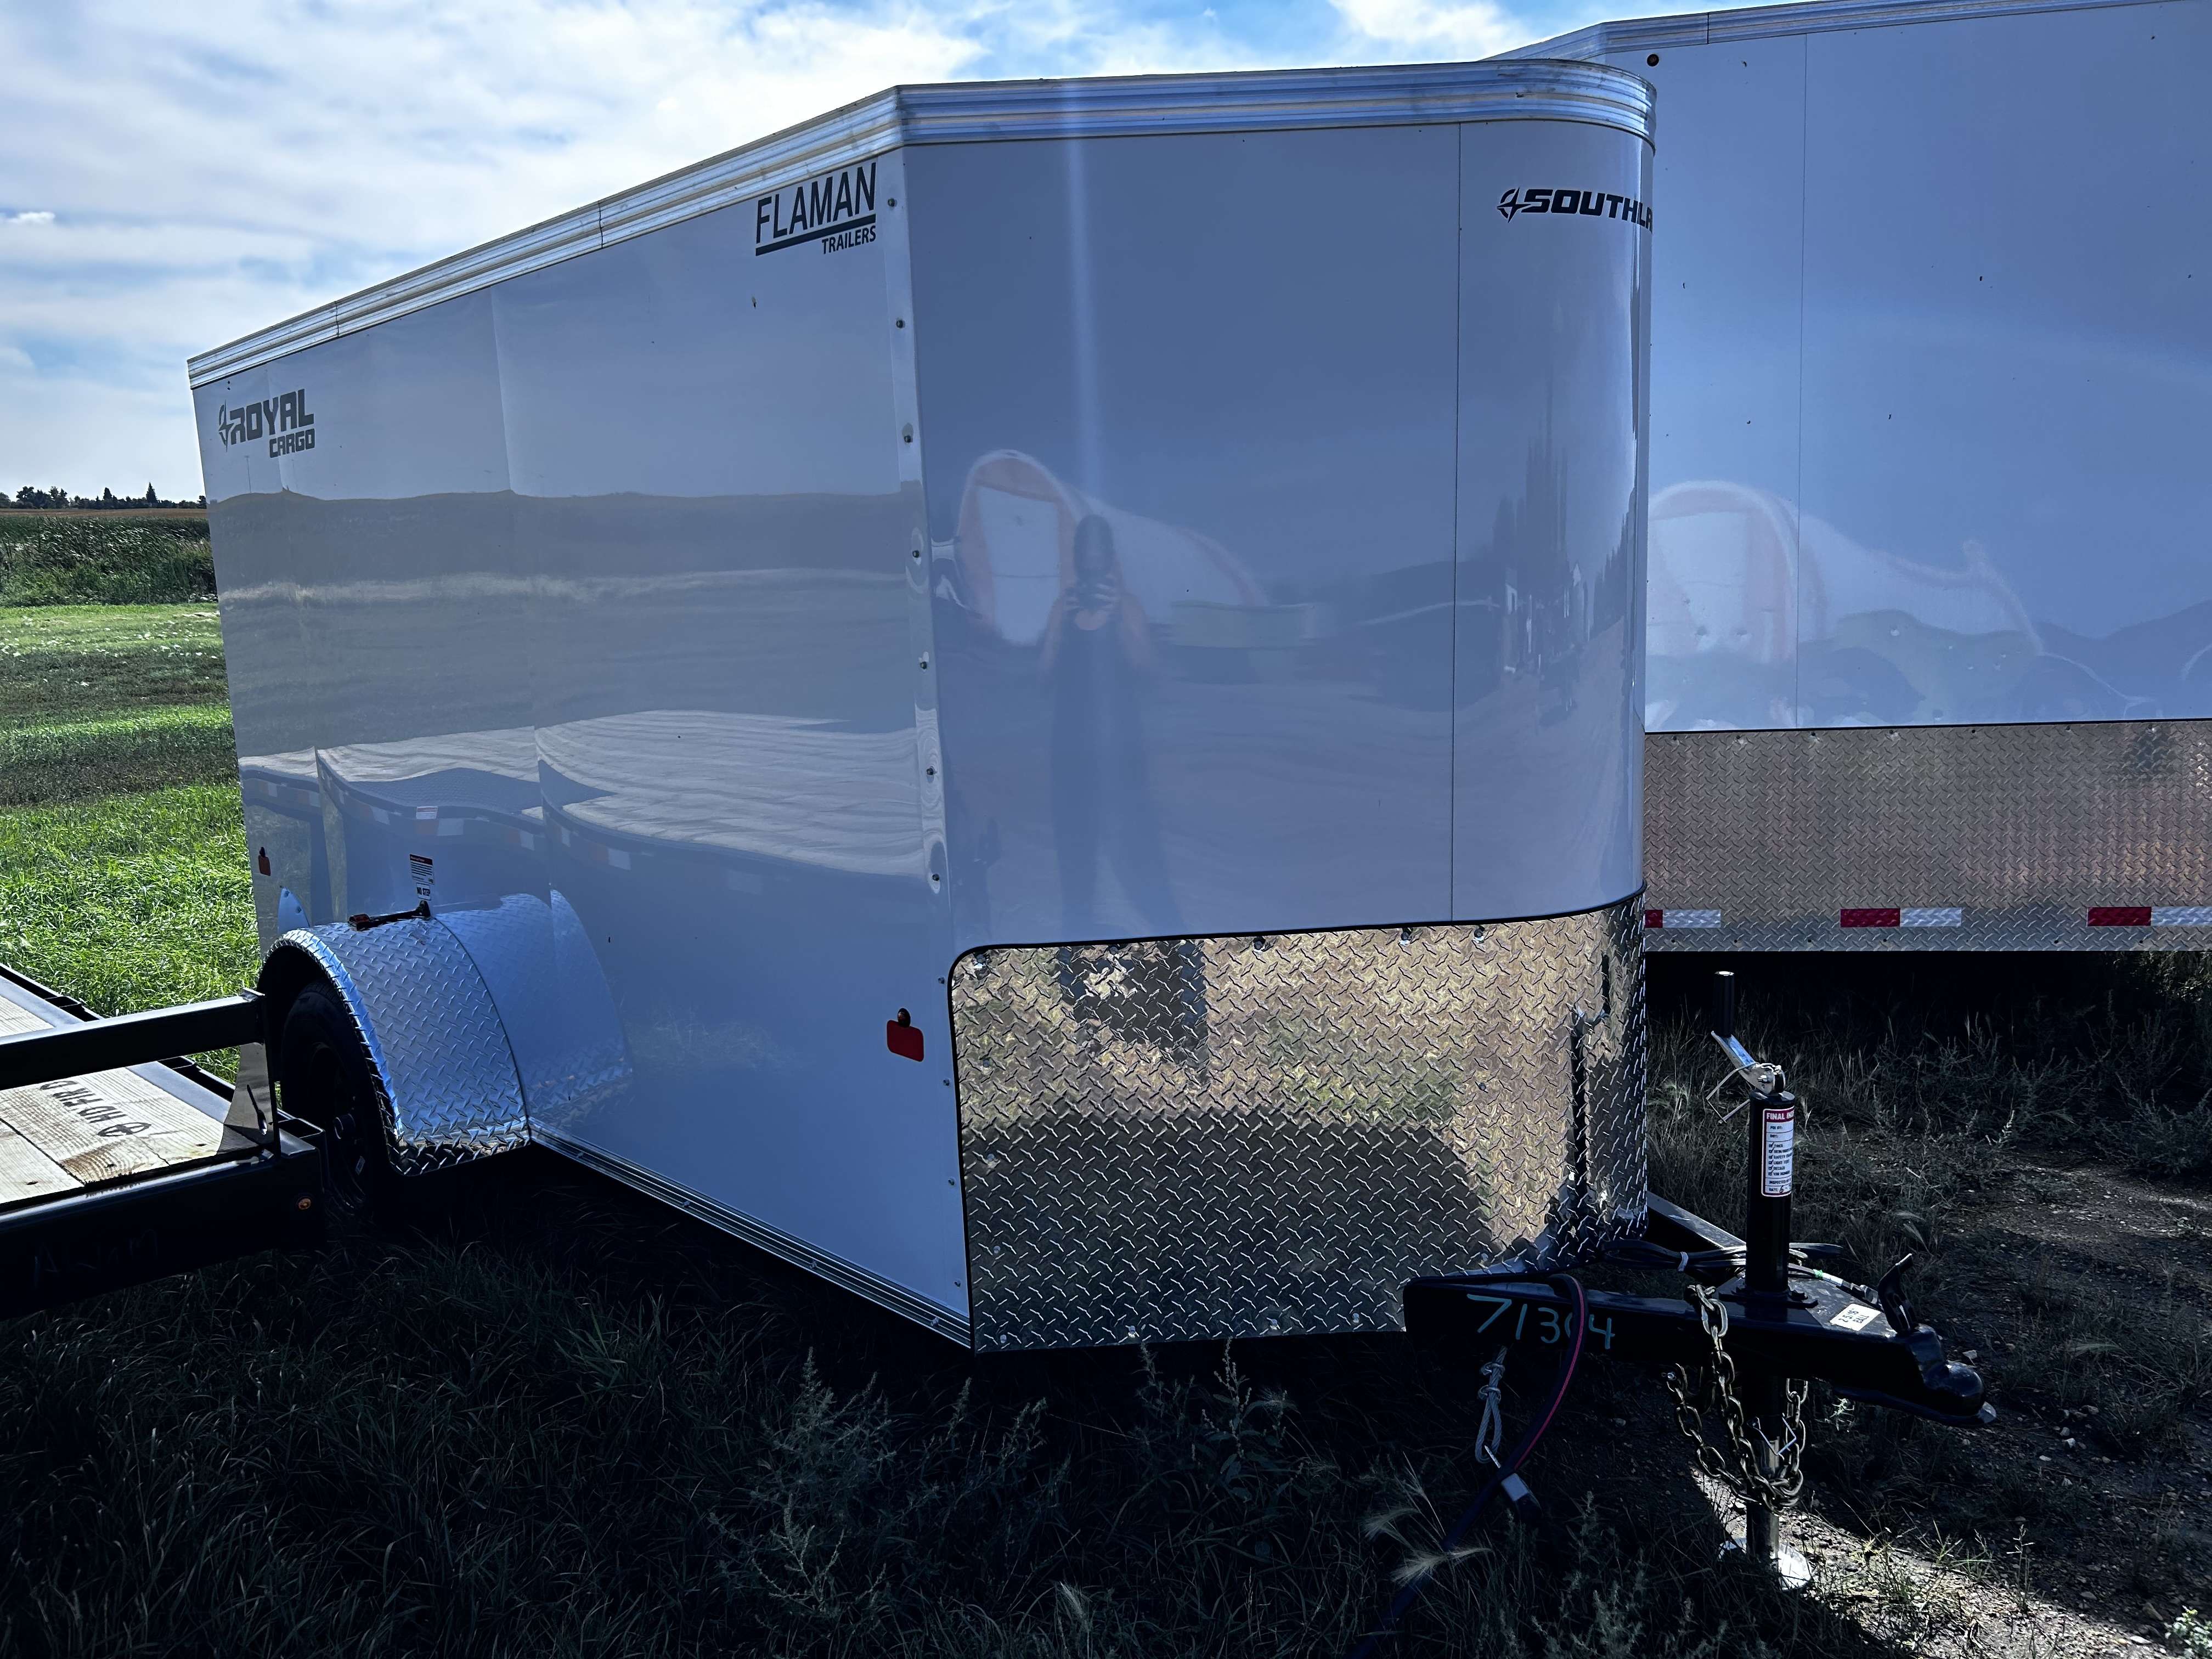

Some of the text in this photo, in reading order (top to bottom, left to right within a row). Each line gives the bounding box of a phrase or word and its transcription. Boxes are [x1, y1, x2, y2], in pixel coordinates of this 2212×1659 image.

[756, 162, 877, 244] FLAMAN
[822, 225, 876, 255] TRAILERS
[229, 388, 314, 445] ROYAL
[269, 428, 315, 458] CARGO
